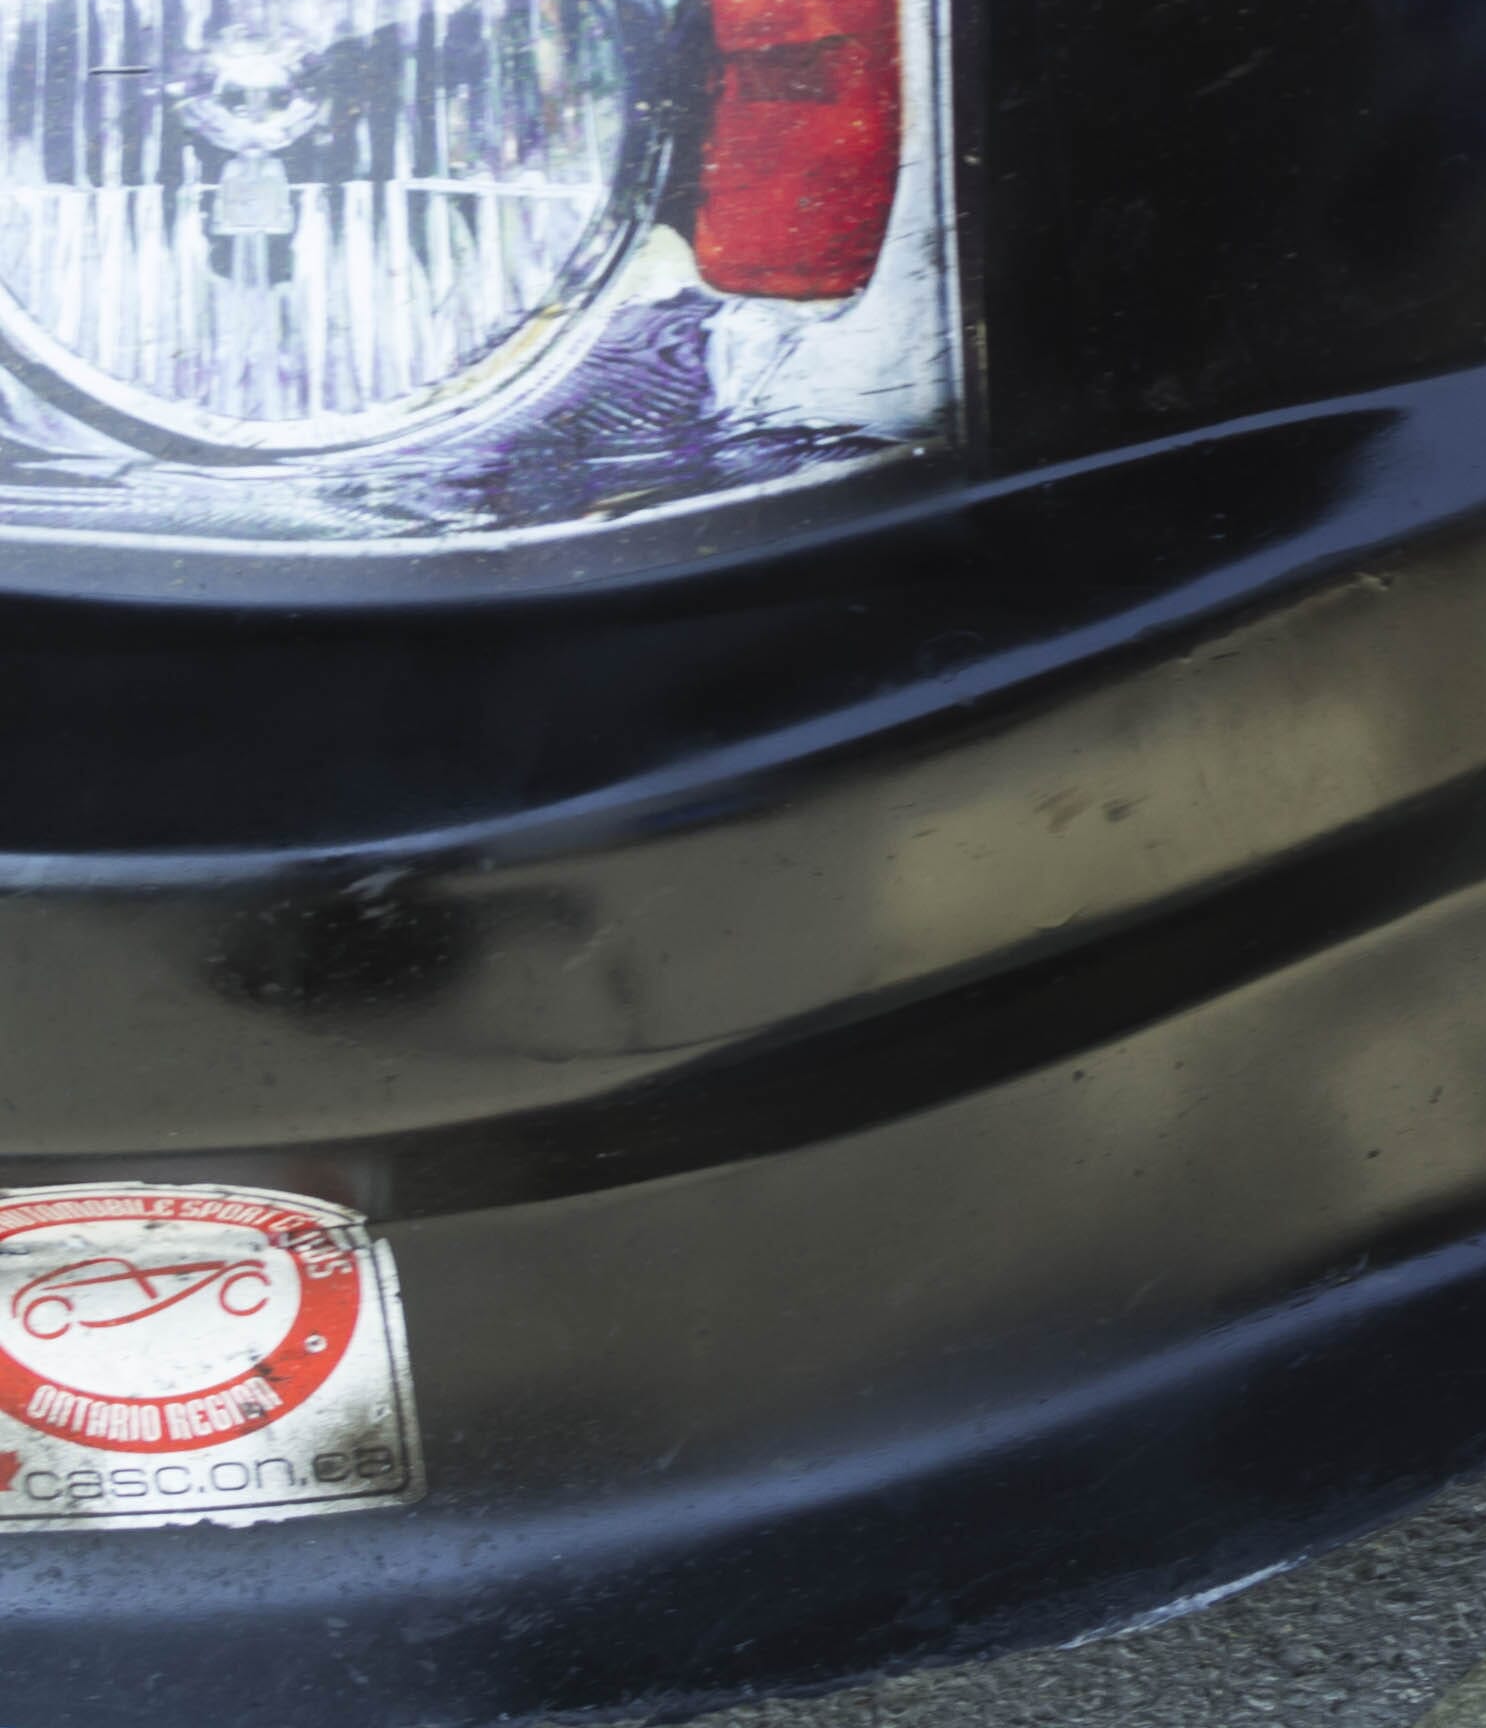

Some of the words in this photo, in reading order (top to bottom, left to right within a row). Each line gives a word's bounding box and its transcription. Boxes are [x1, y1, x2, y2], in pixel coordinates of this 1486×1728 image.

[178, 1199, 283, 1226] SPORT
[26, 1384, 162, 1443] ONTARIO
[164, 1376, 283, 1441] REGION
[24, 1445, 395, 1502] casc.on.ca
